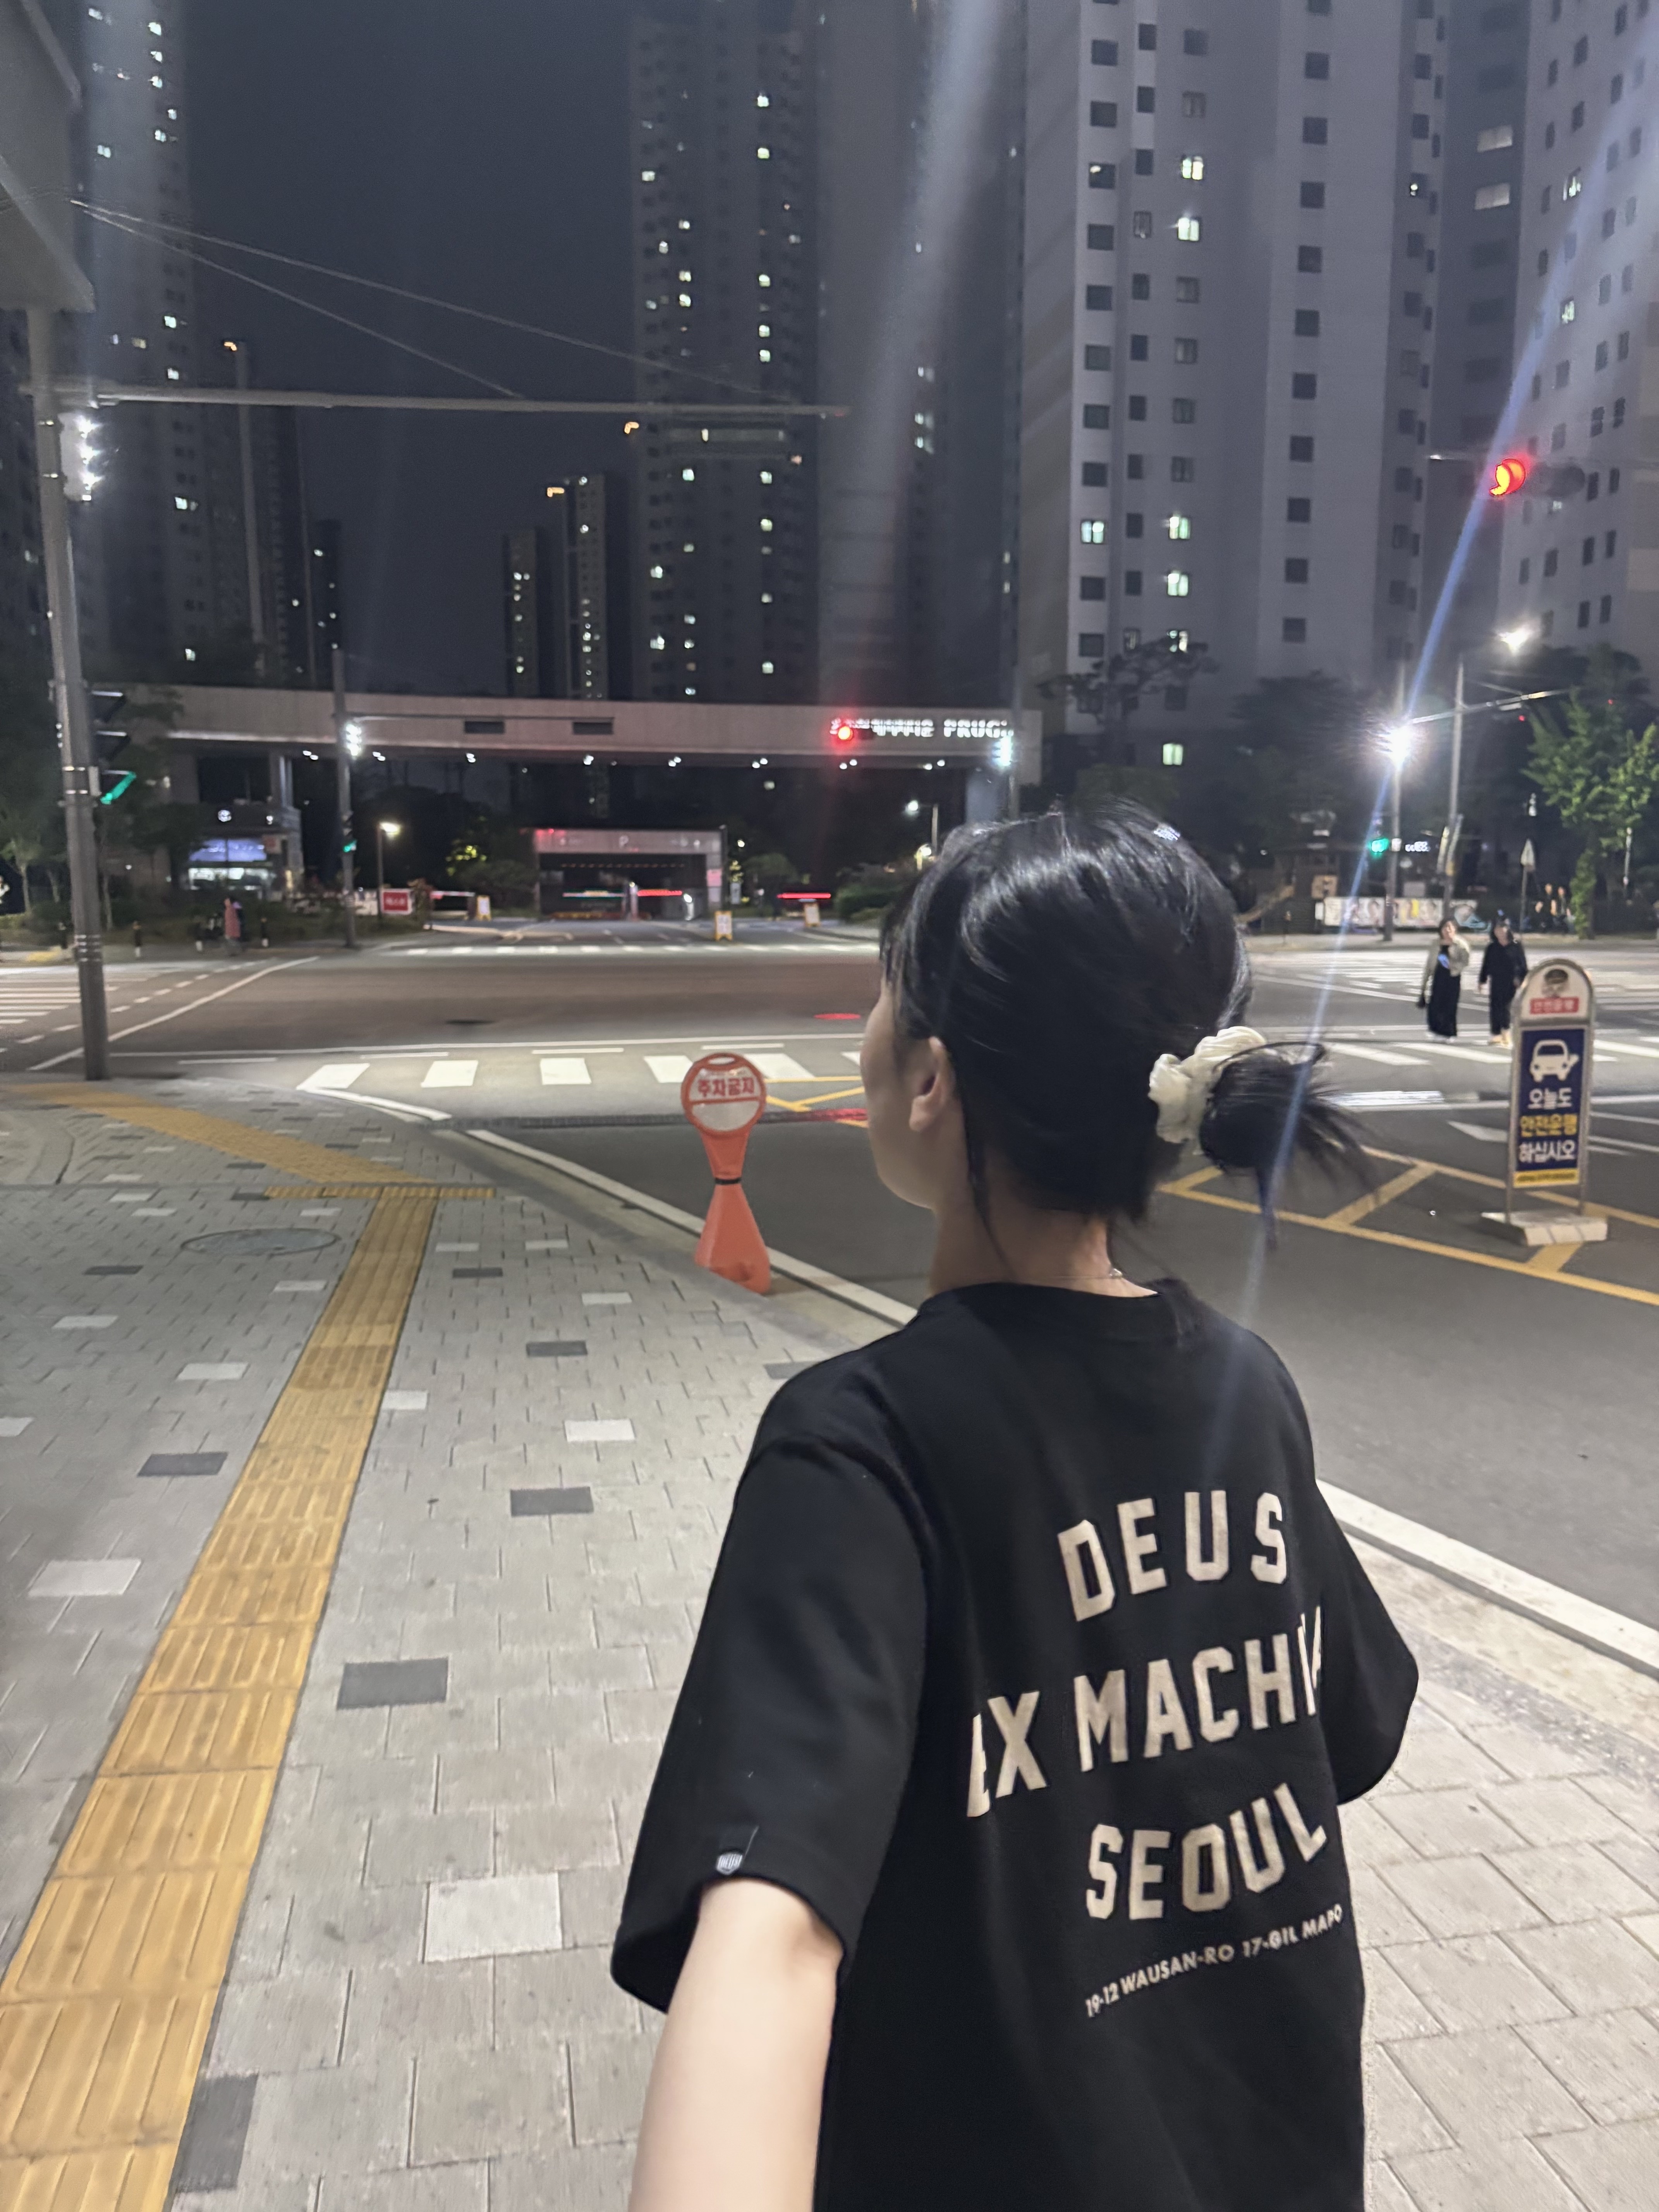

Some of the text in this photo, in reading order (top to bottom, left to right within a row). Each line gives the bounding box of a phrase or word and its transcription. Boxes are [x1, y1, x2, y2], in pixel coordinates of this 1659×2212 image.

[697, 1077, 754, 1097] 주차금지
[1527, 1087, 1573, 1110] 오늘도
[1520, 1113, 1578, 1138] 안전운행
[1519, 1139, 1575, 1164] 하십시오
[1058, 1490, 1287, 1621] DEUS
[1086, 1782, 1328, 1920] SEOUL
[1085, 1903, 1343, 2018] 19-12 WAUSAN-RO 17-GIL MAPO
